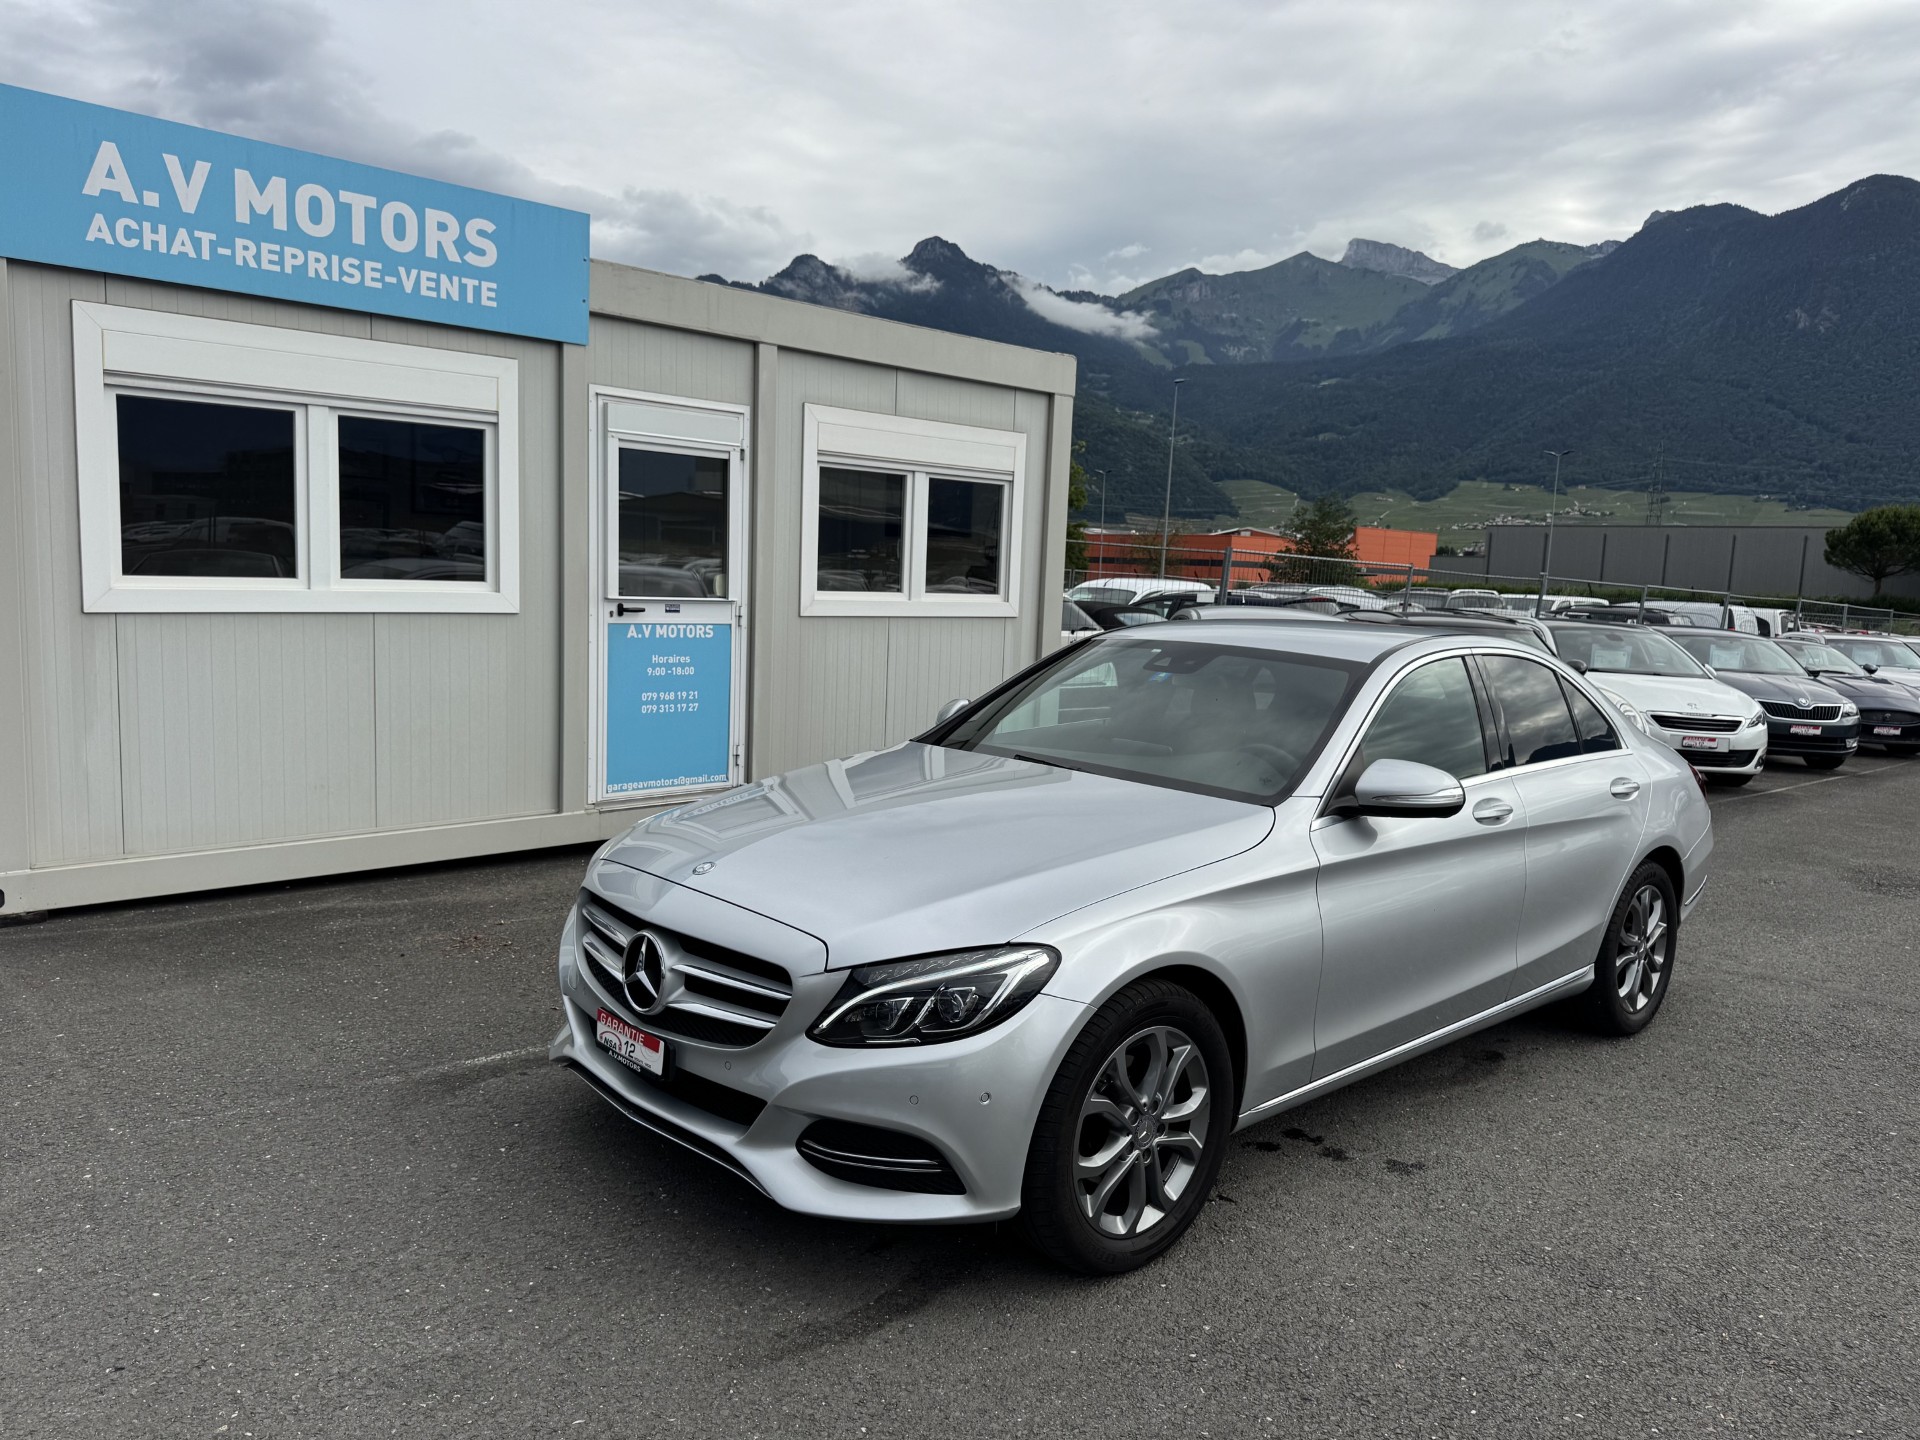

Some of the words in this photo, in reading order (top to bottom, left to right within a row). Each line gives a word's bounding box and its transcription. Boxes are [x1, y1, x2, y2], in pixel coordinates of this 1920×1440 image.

[82, 141, 212, 214] A.V
[234, 168, 498, 268] MOTORS
[85, 213, 498, 308] ACHAT-REPRISE-VENTE
[626, 624, 652, 639] A.V
[655, 624, 714, 639] MOTORS
[652, 654, 690, 663] Horaires
[647, 667, 666, 676] 9:00
[641, 692, 657, 701] 079
[659, 691, 675, 700] 968
[677, 691, 687, 700] 19
[688, 690, 698, 700] 21
[641, 705, 657, 714] 079
[659, 704, 675, 712] 313
[677, 703, 687, 712] 17
[688, 702, 699, 712] 27
[607, 773, 727, 793] garageavmotors@gmail.com
[600, 1013, 645, 1046] GARANTIE
[603, 1036, 617, 1050] NSA
[624, 1040, 636, 1059] 12
